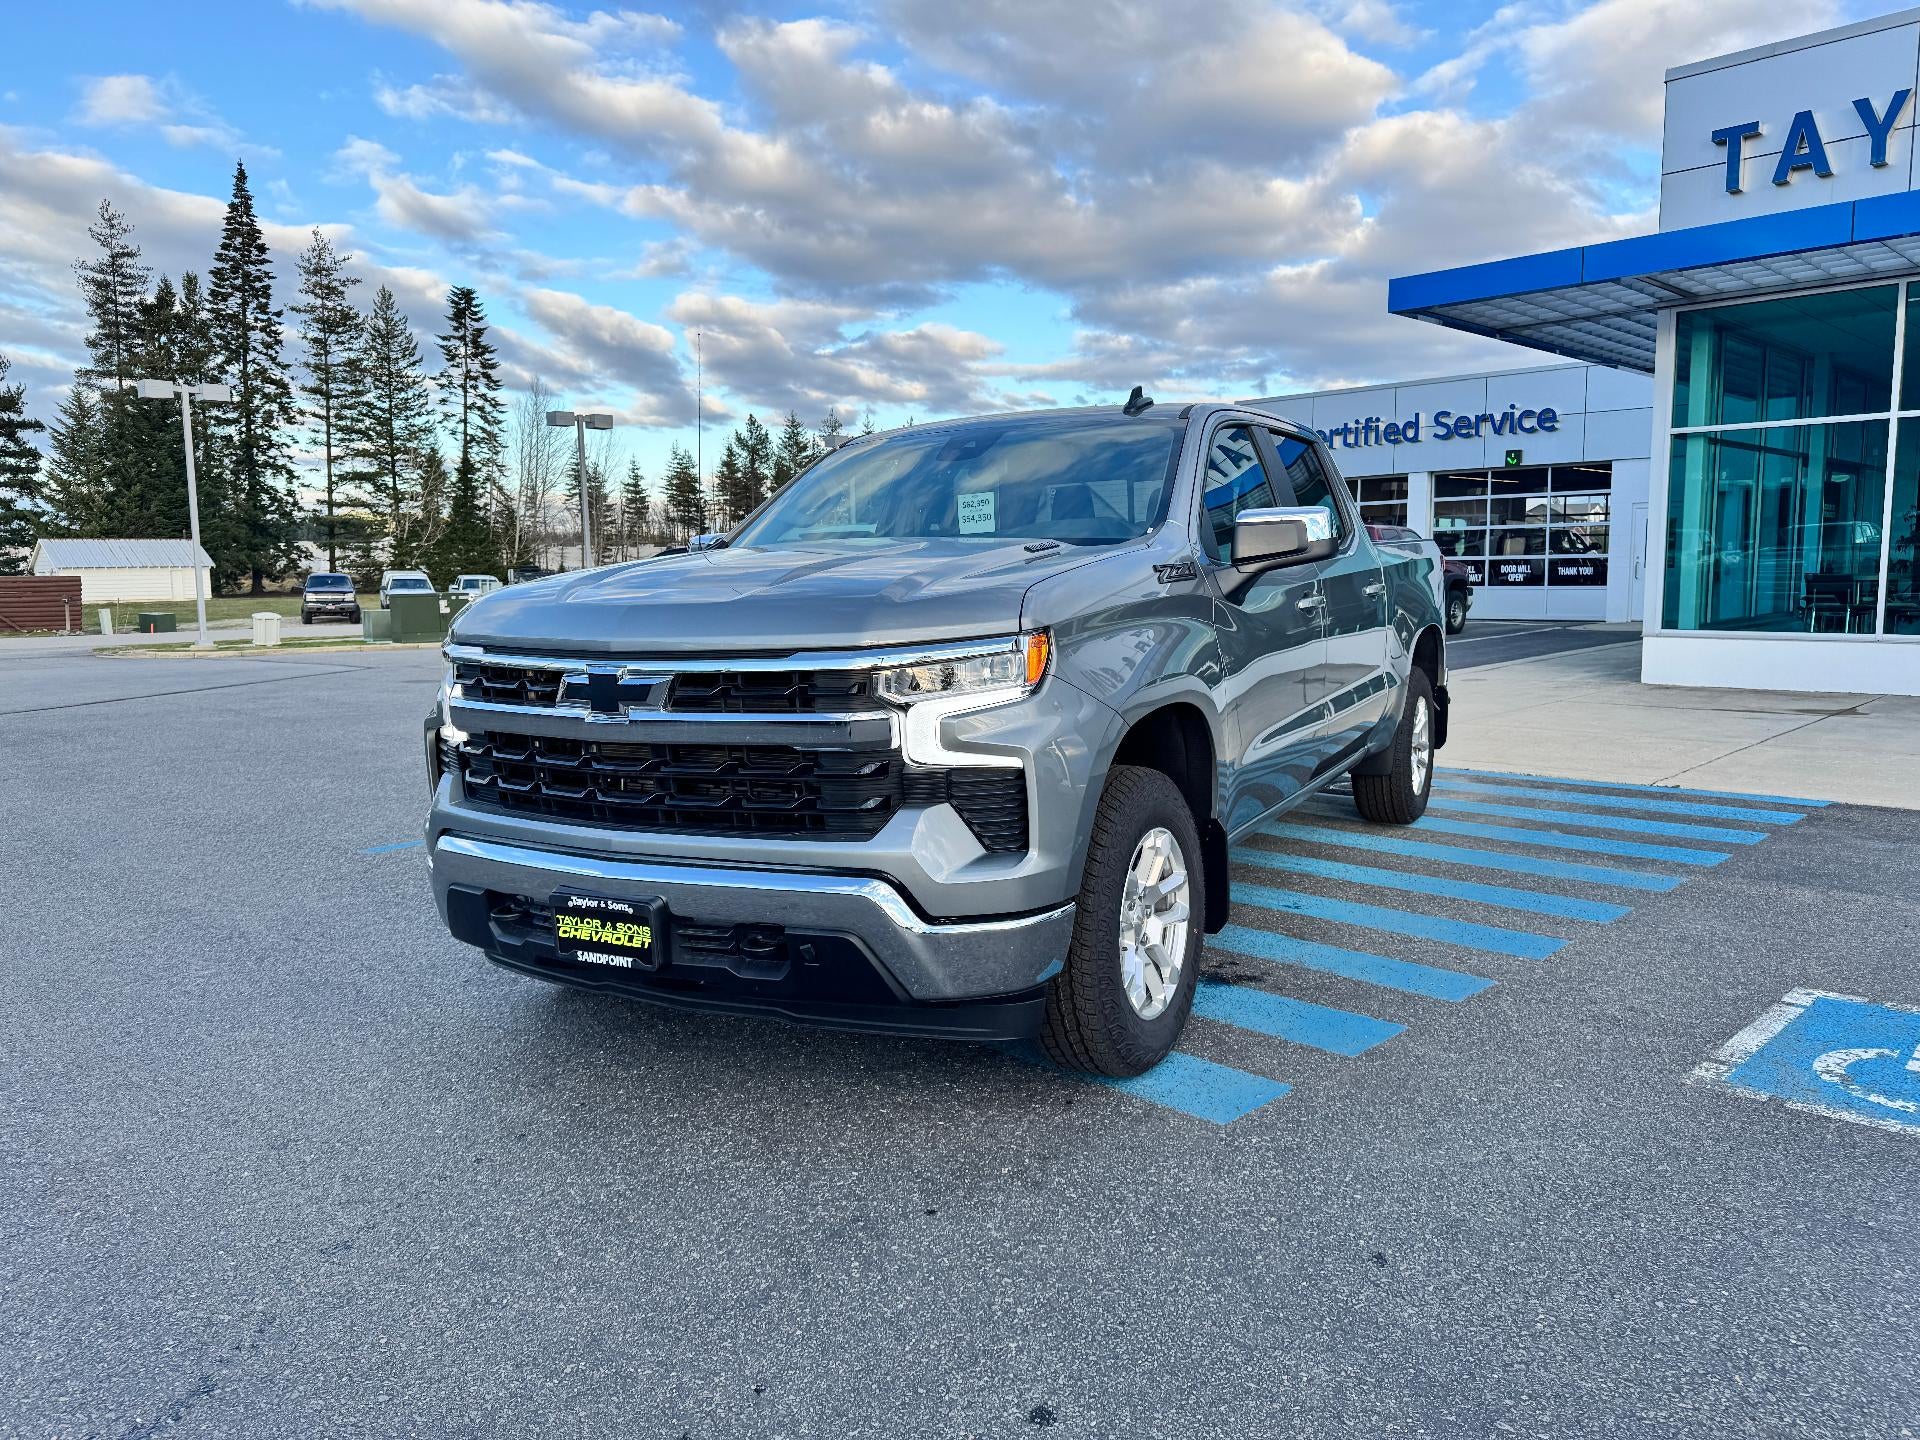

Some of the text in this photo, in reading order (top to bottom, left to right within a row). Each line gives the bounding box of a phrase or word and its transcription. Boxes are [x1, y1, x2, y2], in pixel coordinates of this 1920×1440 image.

[1711, 88, 1913, 194] TAY
[1316, 403, 1558, 449] ertified Service
[1500, 565, 1532, 574] DOOR WILL
[1558, 566, 1594, 576] THANK YOU!
[571, 896, 598, 909] Taylor
[607, 901, 629, 912] Sons
[556, 914, 651, 937] TAYLOR & SONS
[558, 926, 652, 949] CHEVROLET
[577, 951, 633, 968] SANDPOINT
